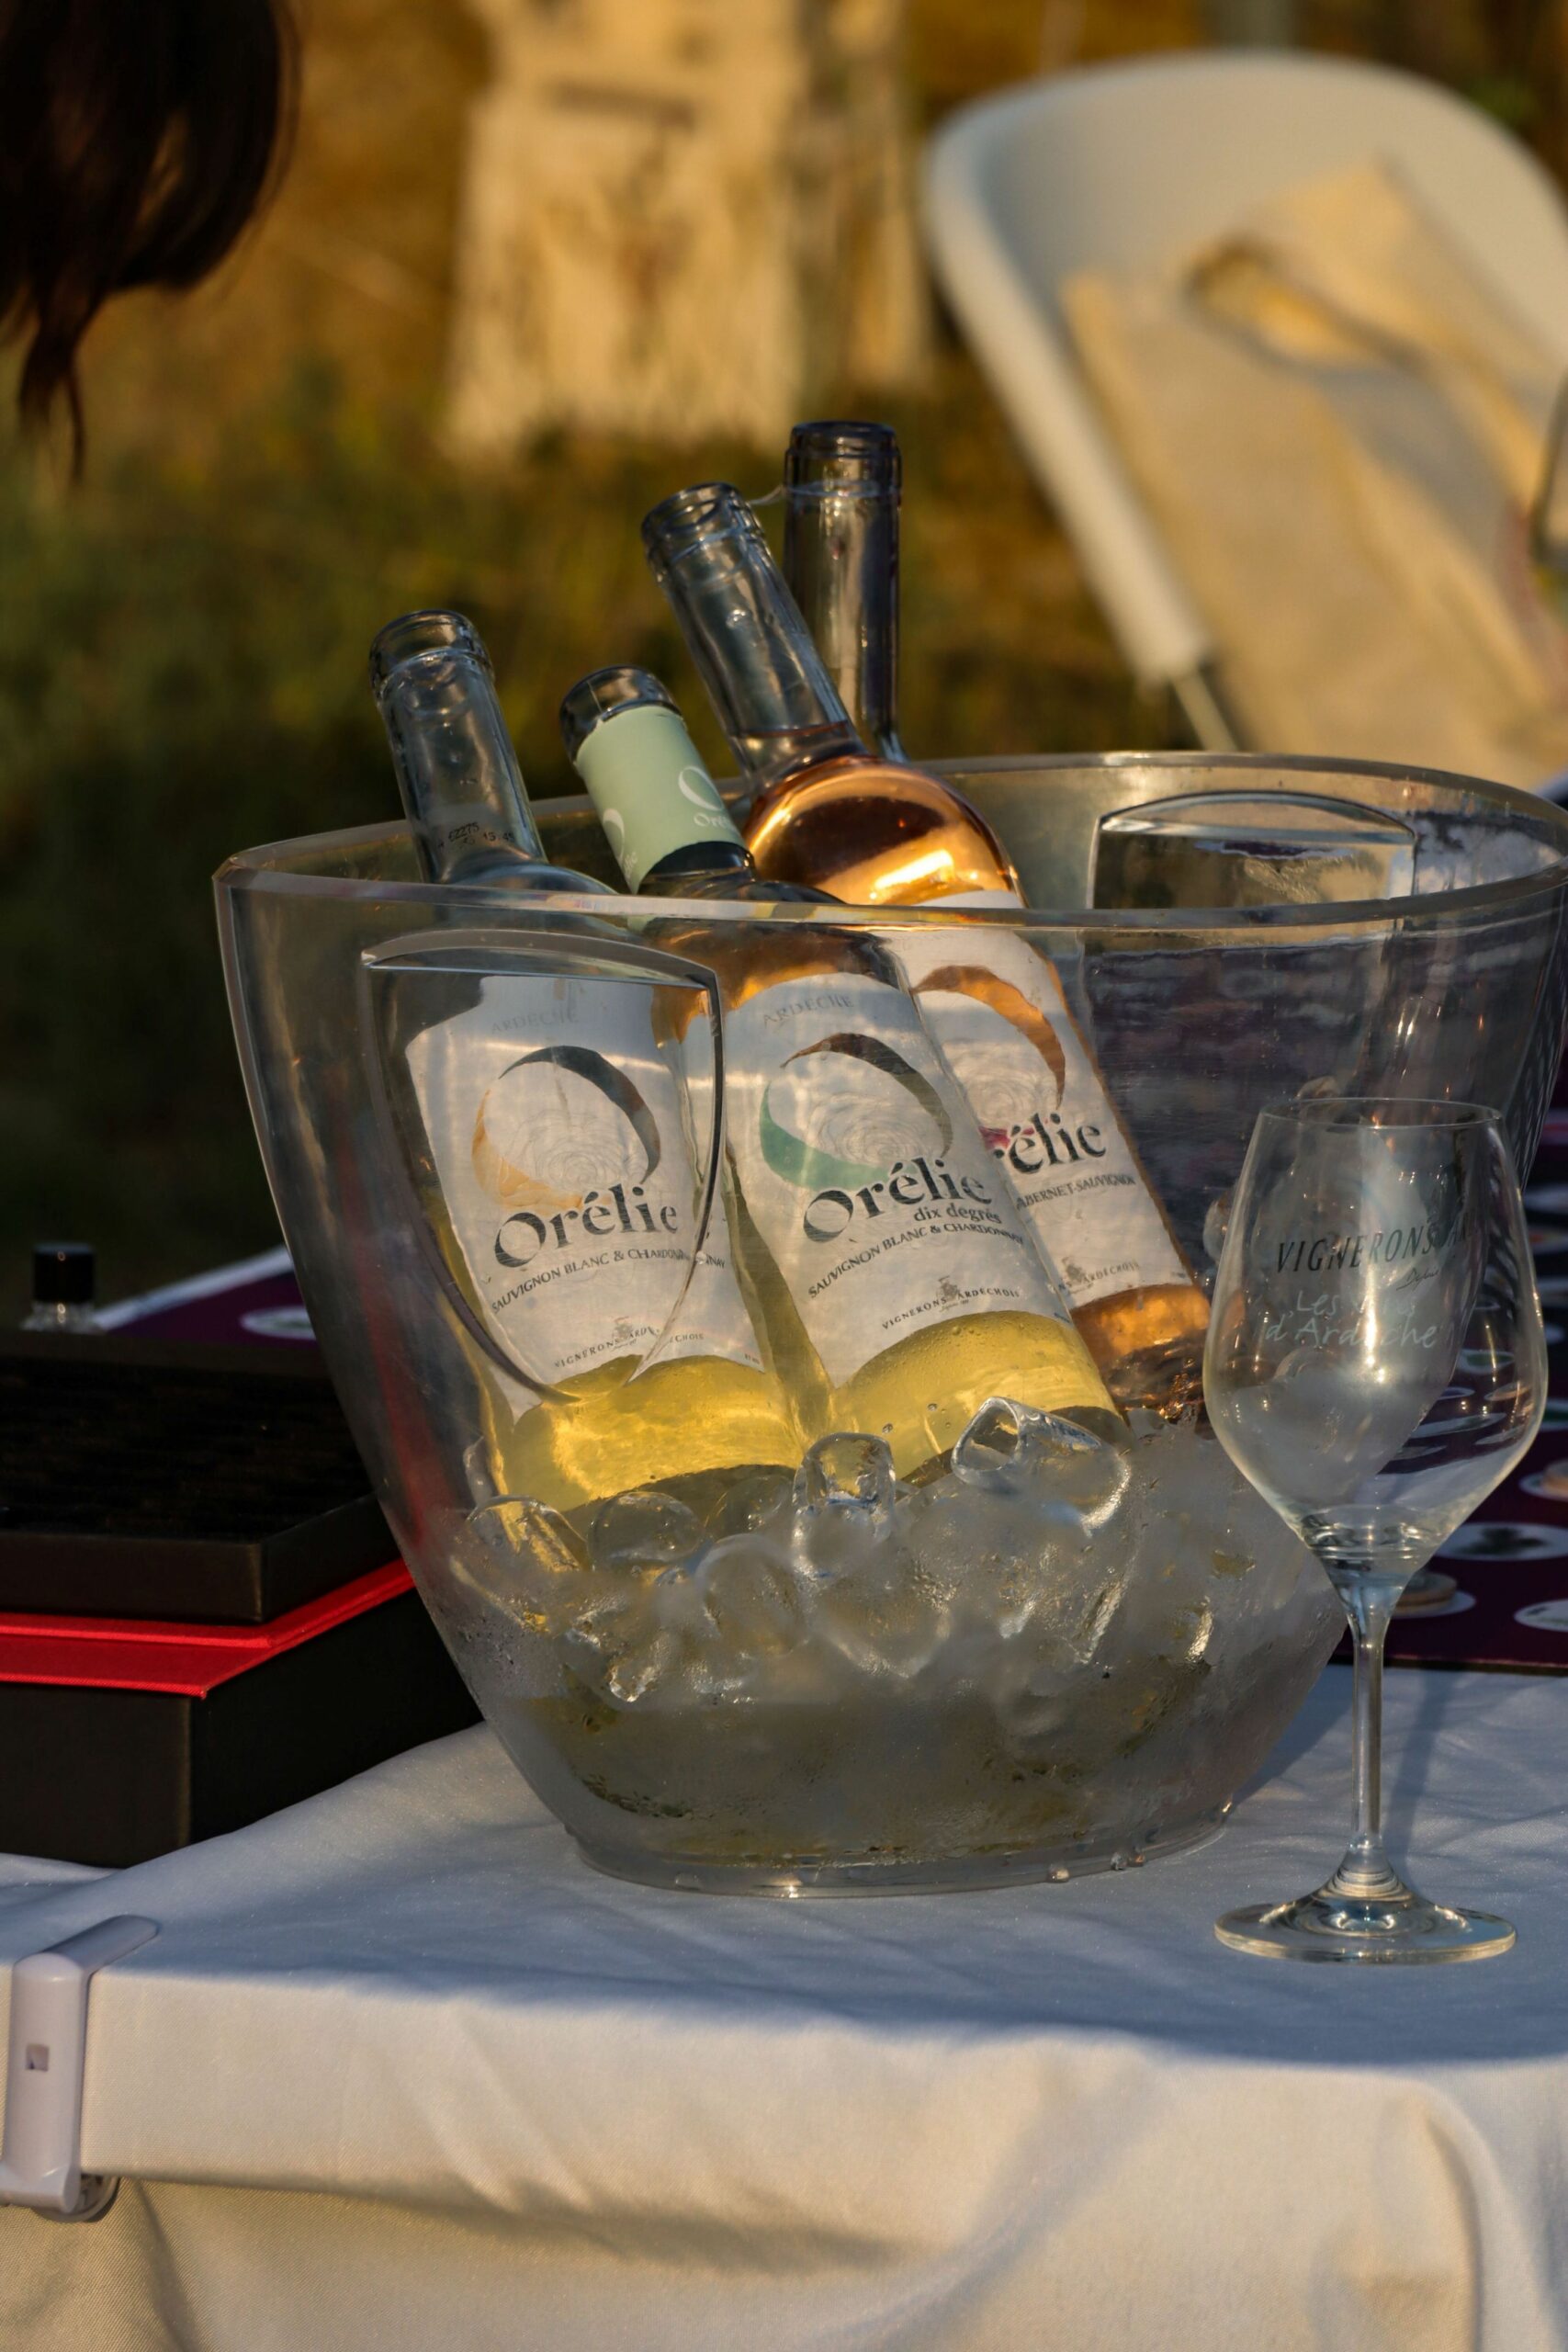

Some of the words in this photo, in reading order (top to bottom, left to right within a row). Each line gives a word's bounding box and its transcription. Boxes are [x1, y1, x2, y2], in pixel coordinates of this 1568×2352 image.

[803, 1157, 992, 1242] Orélie
[913, 1205, 942, 1221] dix
[1015, 1174, 1136, 1211] ABERNET-SAUVIGNON
[494, 1183, 678, 1267] Orélie
[1277, 1224, 1435, 1272] VIGNERONS
[492, 1265, 561, 1314] SAUVIGNON
[564, 1252, 610, 1274] BLANC
[614, 1250, 625, 1261] &
[807, 1245, 880, 1298] SAUVIGNON
[882, 1227, 928, 1250] BLANC
[930, 1225, 942, 1234] &
[943, 1223, 1024, 1245] CHARDONNAY
[882, 1296, 947, 1330] VIGNERONS
[1296, 1290, 1339, 1316] Les
